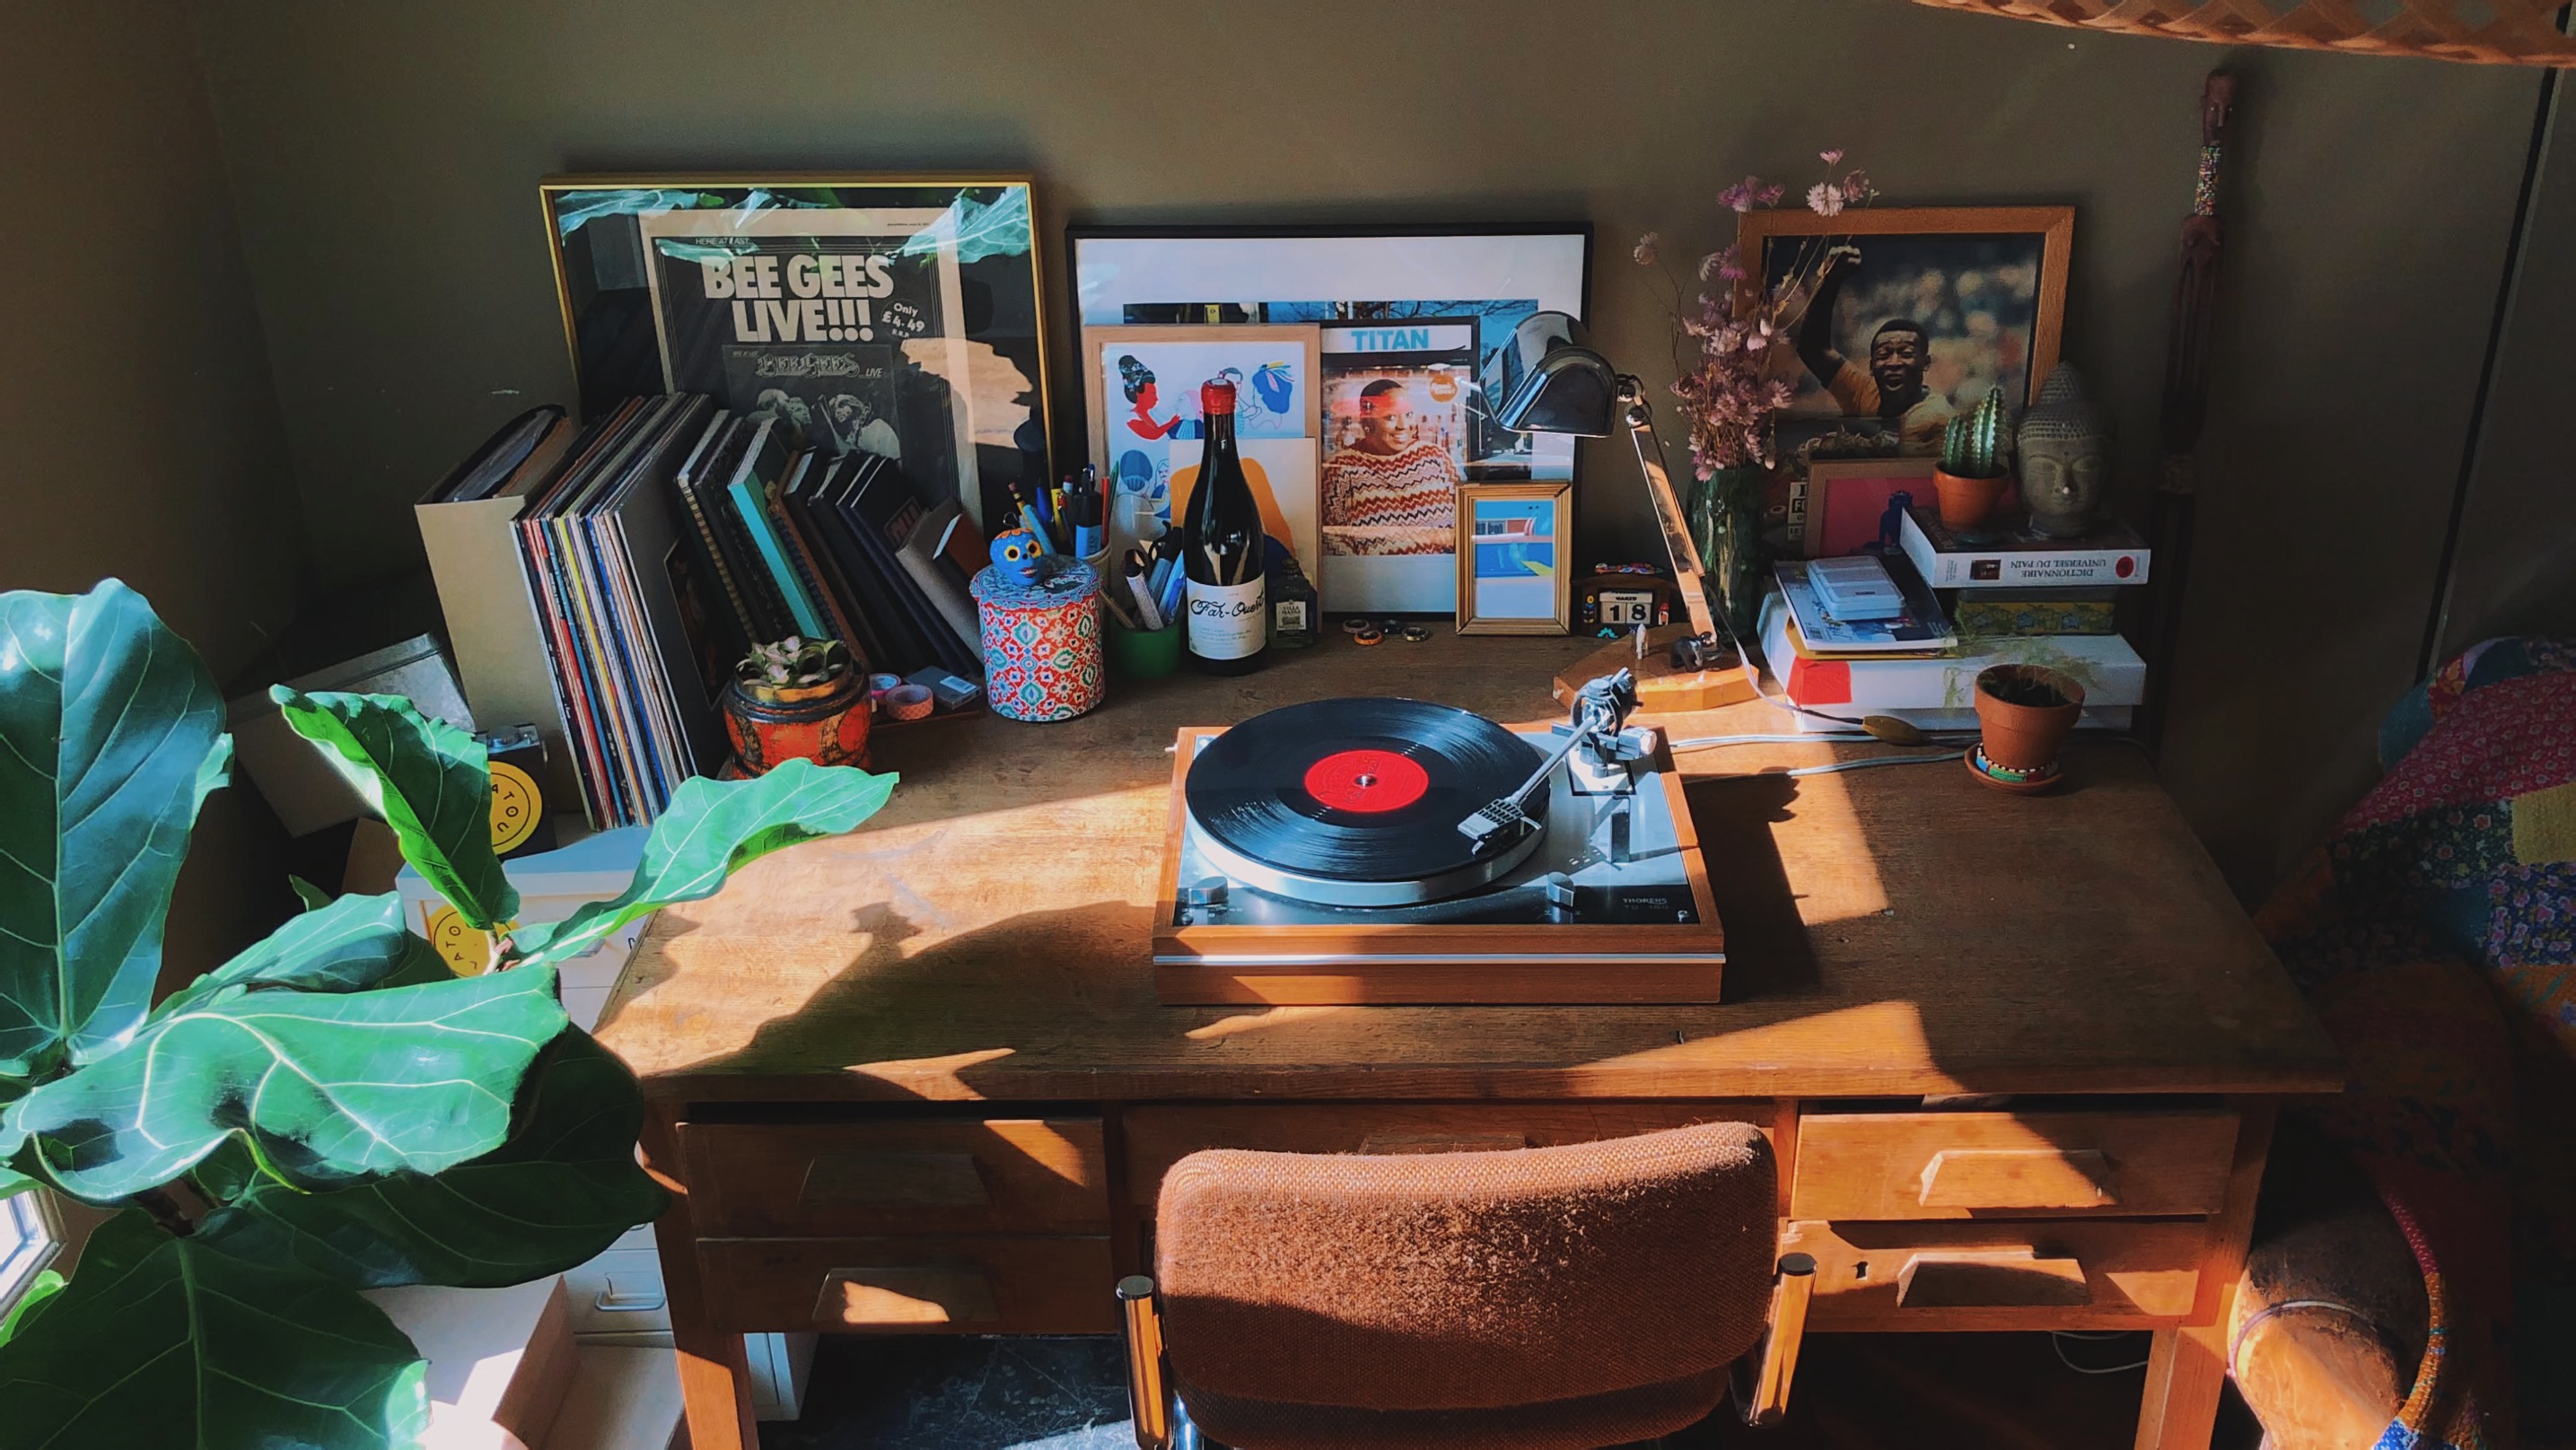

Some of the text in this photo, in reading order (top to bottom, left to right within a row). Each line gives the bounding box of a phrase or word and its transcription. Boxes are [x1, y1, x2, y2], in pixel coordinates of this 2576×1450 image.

[700, 254, 895, 299] BEE GEES
[893, 302, 918, 318] Only
[732, 299, 874, 343] LIVE!!!
[1351, 328, 1429, 351] TITAN
[2011, 559, 2107, 569] UNIVERSEL DU PAIN
[2021, 569, 2094, 578] DICTIONNAIRE
